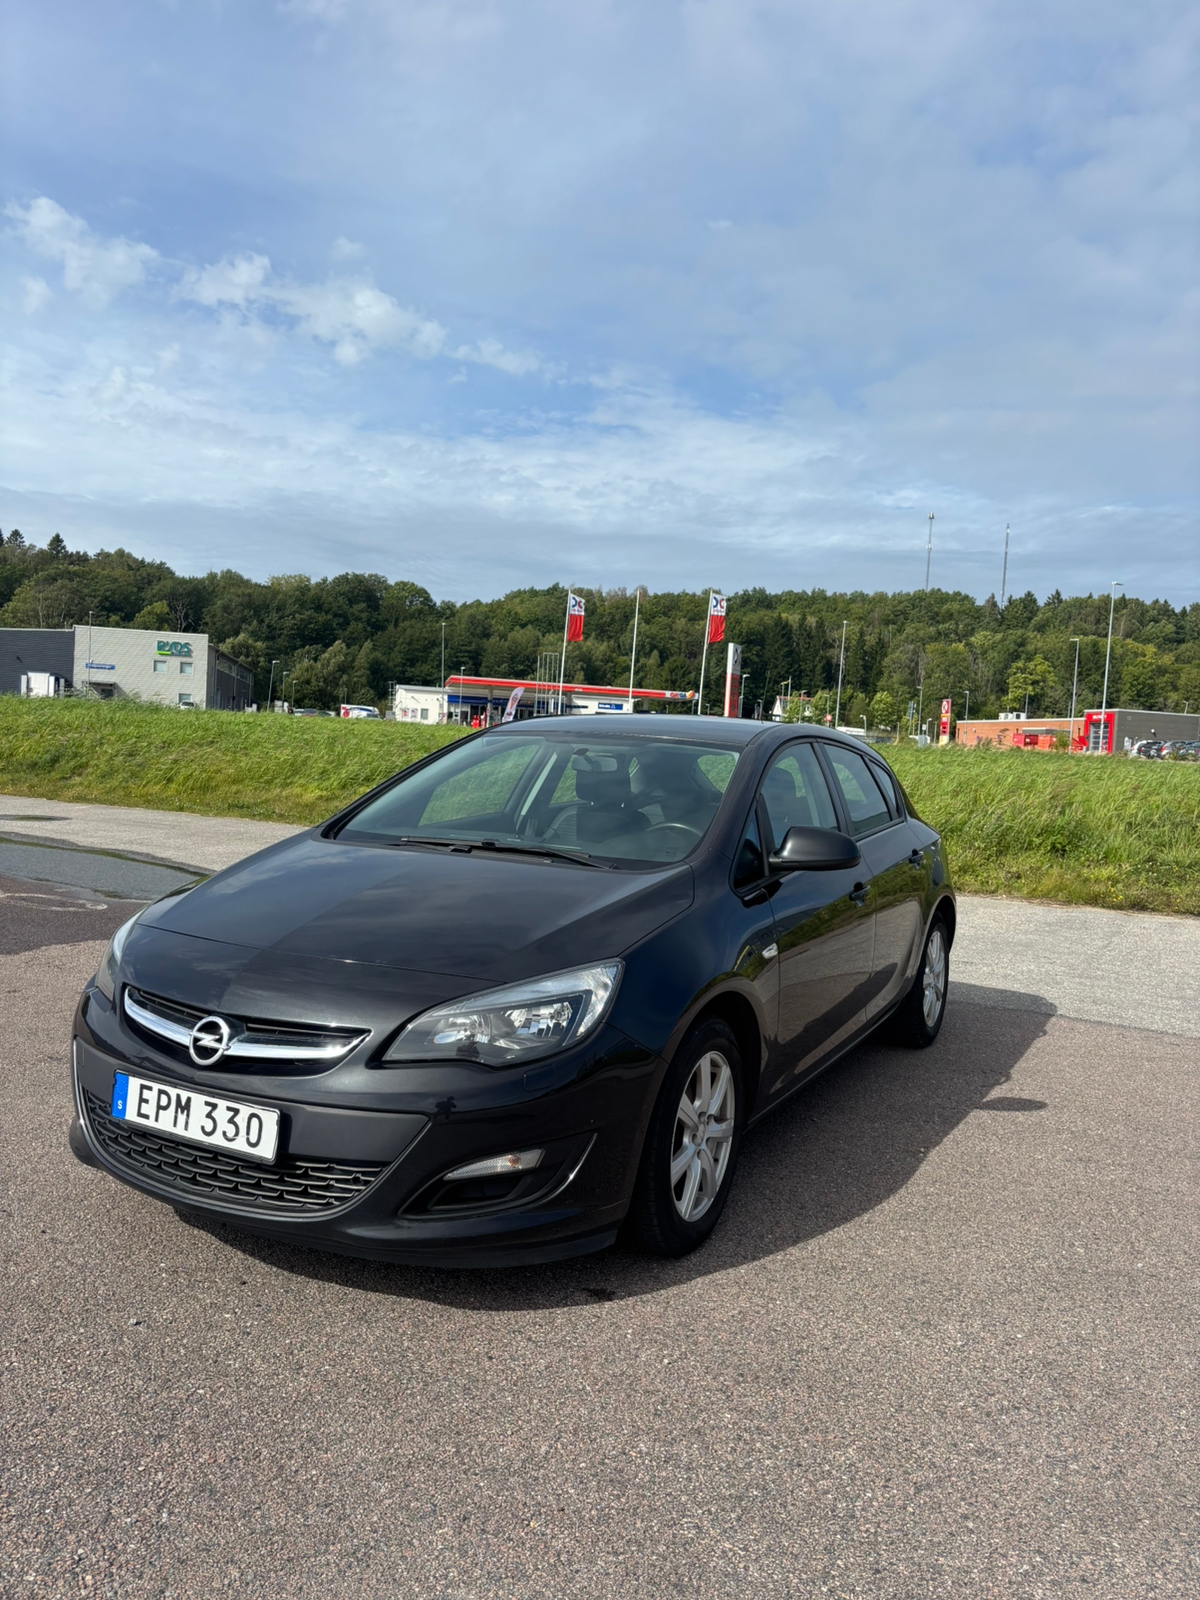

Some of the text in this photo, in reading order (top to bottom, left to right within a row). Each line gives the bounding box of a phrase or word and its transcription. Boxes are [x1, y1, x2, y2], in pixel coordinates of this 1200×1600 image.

[117, 1099, 123, 1110] S
[136, 1083, 263, 1149] EPM 330
